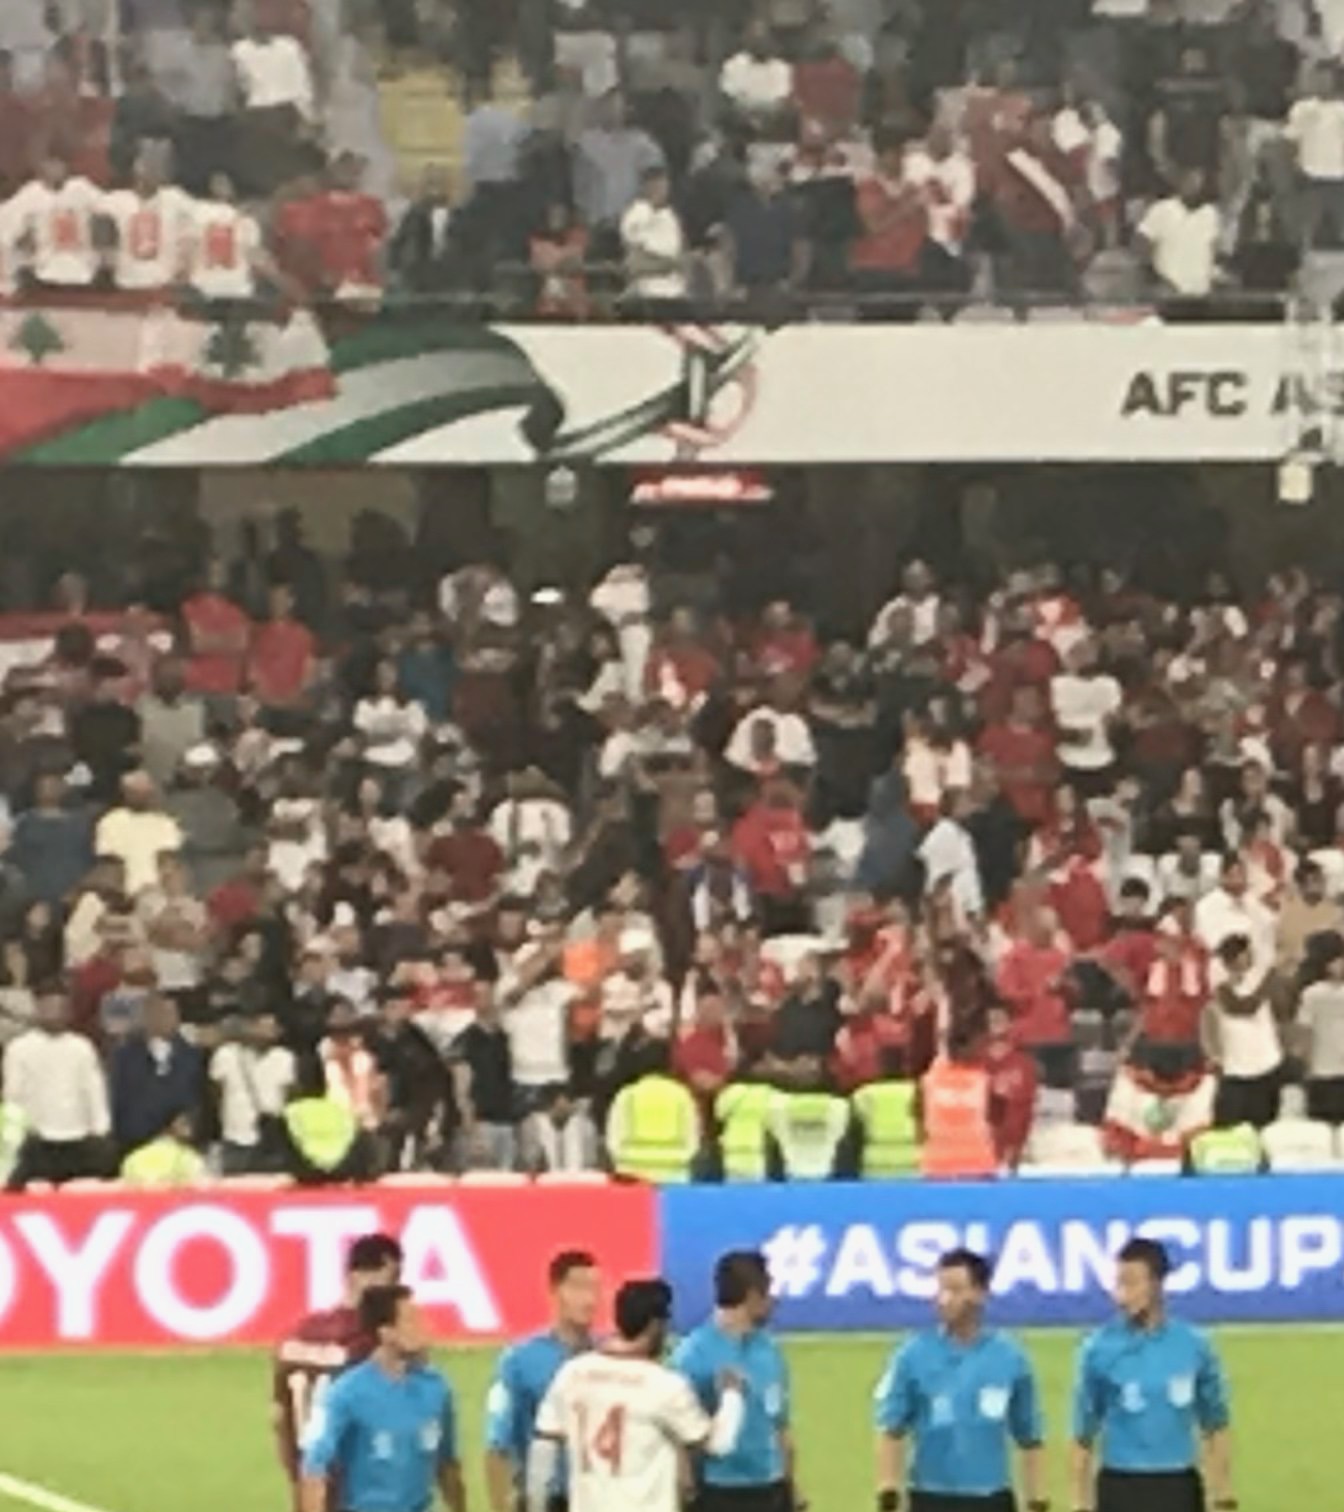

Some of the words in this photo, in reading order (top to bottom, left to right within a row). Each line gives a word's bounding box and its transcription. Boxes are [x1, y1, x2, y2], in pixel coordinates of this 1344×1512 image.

[1121, 371, 1247, 418] AFC
[0, 1203, 502, 1340] YOTA
[573, 1401, 626, 1476] 14
